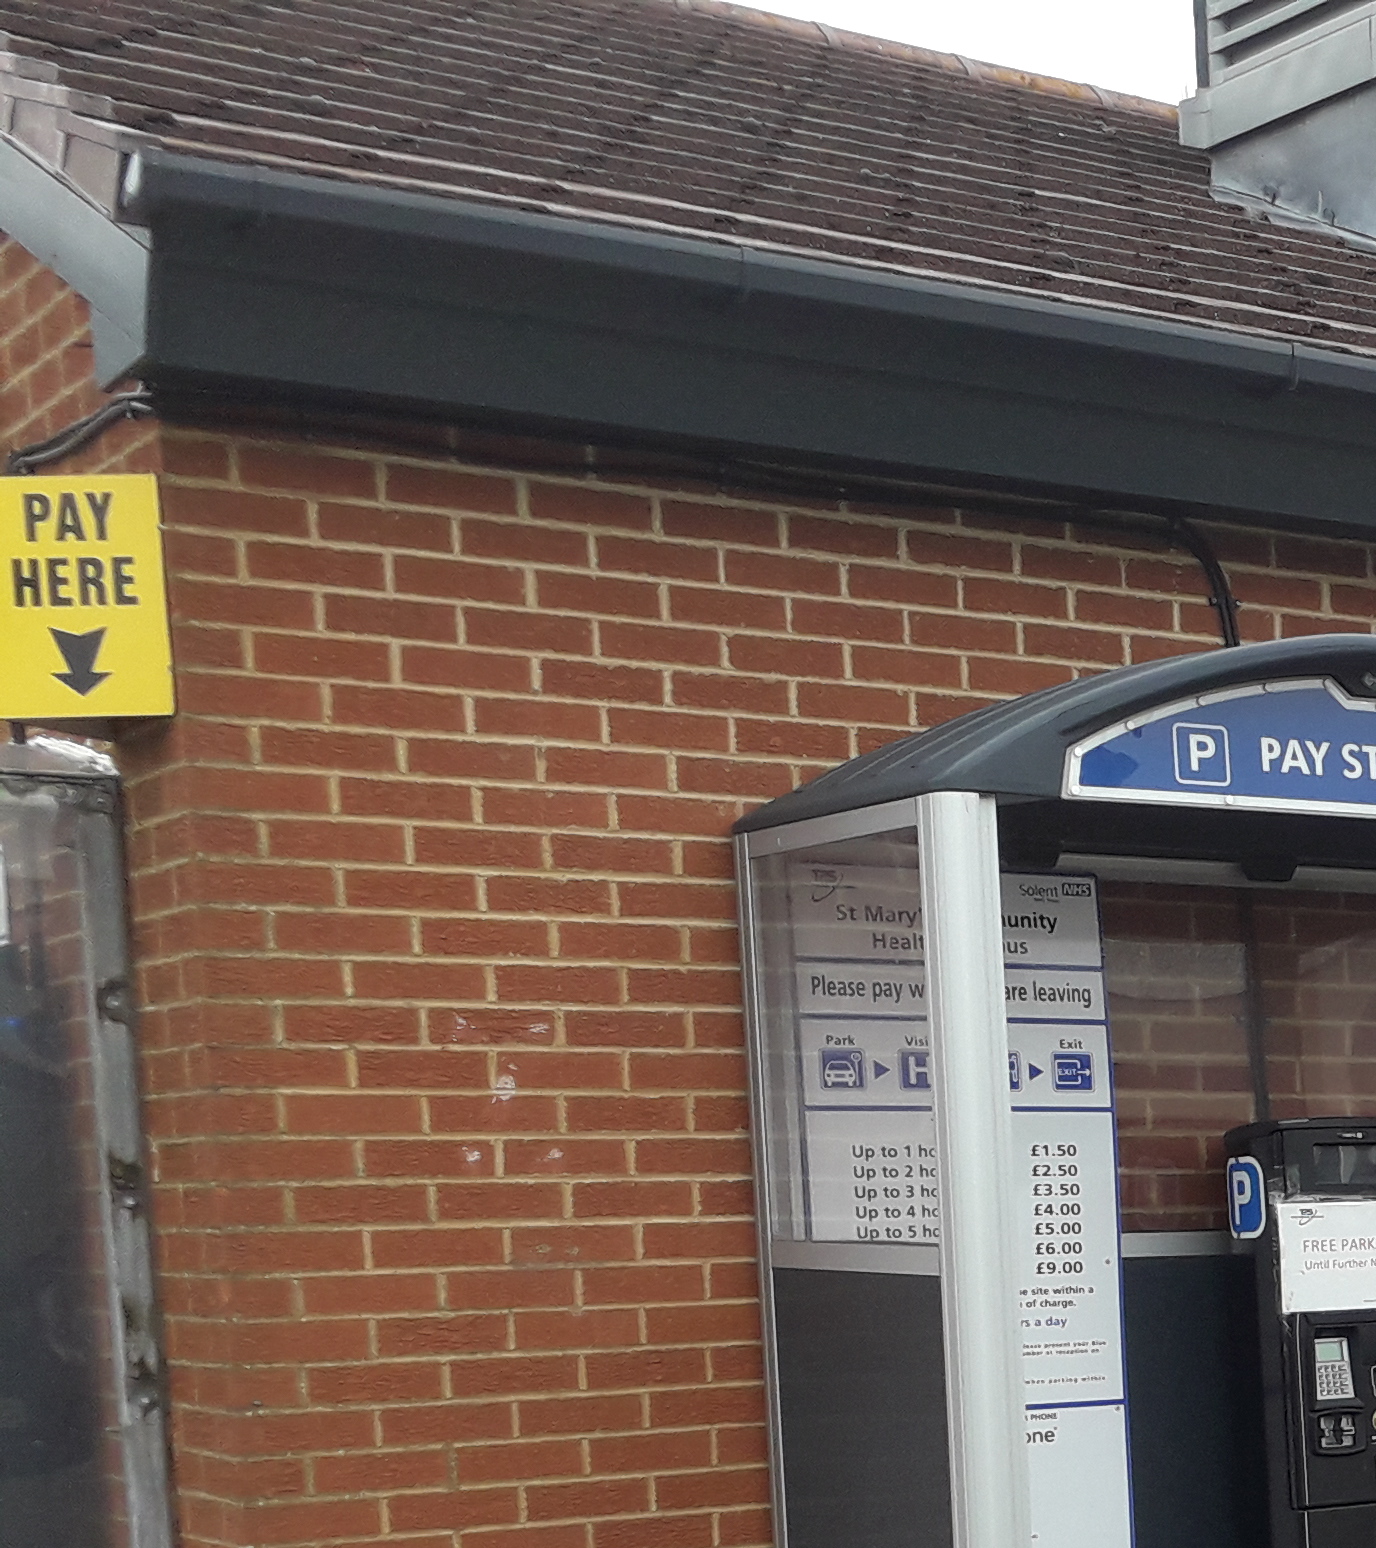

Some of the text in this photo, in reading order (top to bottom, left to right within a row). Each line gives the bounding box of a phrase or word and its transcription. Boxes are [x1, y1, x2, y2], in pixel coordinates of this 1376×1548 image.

[23, 492, 113, 542] PAY
[11, 556, 140, 607] HERE
[1188, 733, 1216, 772] P
[1260, 737, 1331, 777] PAY
[1019, 883, 1091, 898] Solent NHS
[836, 904, 857, 921] St
[864, 905, 922, 928] Mary'
[872, 932, 925, 950] Healt
[811, 975, 866, 998] Please
[872, 980, 903, 1004] pay
[1033, 981, 1092, 1008] leaving
[825, 1035, 1084, 1050] Park Visi Exit
[1057, 1067, 1078, 1077] EXIT
[852, 1144, 876, 1161] Up
[880, 1145, 898, 1159] to
[904, 1145, 912, 1158] 1
[1031, 1144, 1077, 1157] £1.50
[853, 1165, 877, 1181] Up
[882, 1166, 899, 1179] to
[904, 1165, 914, 1178] 2
[1032, 1164, 1078, 1177] £2.50
[854, 1185, 878, 1202] Up
[883, 1186, 900, 1199] to
[905, 1185, 915, 1198] 3
[1033, 1183, 1081, 1197] £3.50
[1233, 1171, 1251, 1226] P
[855, 1205, 879, 1222] Up
[884, 1206, 901, 1219] to
[906, 1205, 916, 1219] 4
[1034, 1203, 1081, 1216] £4.00
[857, 1226, 880, 1241] Up
[885, 1226, 902, 1239] to
[907, 1226, 917, 1239] 5
[1035, 1222, 1082, 1236] £5.00
[1035, 1242, 1083, 1255] £6.00
[1303, 1239, 1337, 1253] FREE
[1036, 1261, 1084, 1275] £9.00
[1305, 1259, 1330, 1270] Until
[1332, 1258, 1368, 1269] Further
[1031, 1286, 1050, 1296] site
[1052, 1285, 1085, 1296] within
[1087, 1286, 1095, 1295] a
[1025, 1299, 1077, 1310] of charge.
[1034, 1317, 1042, 1328] a
[1045, 1316, 1068, 1329] day
